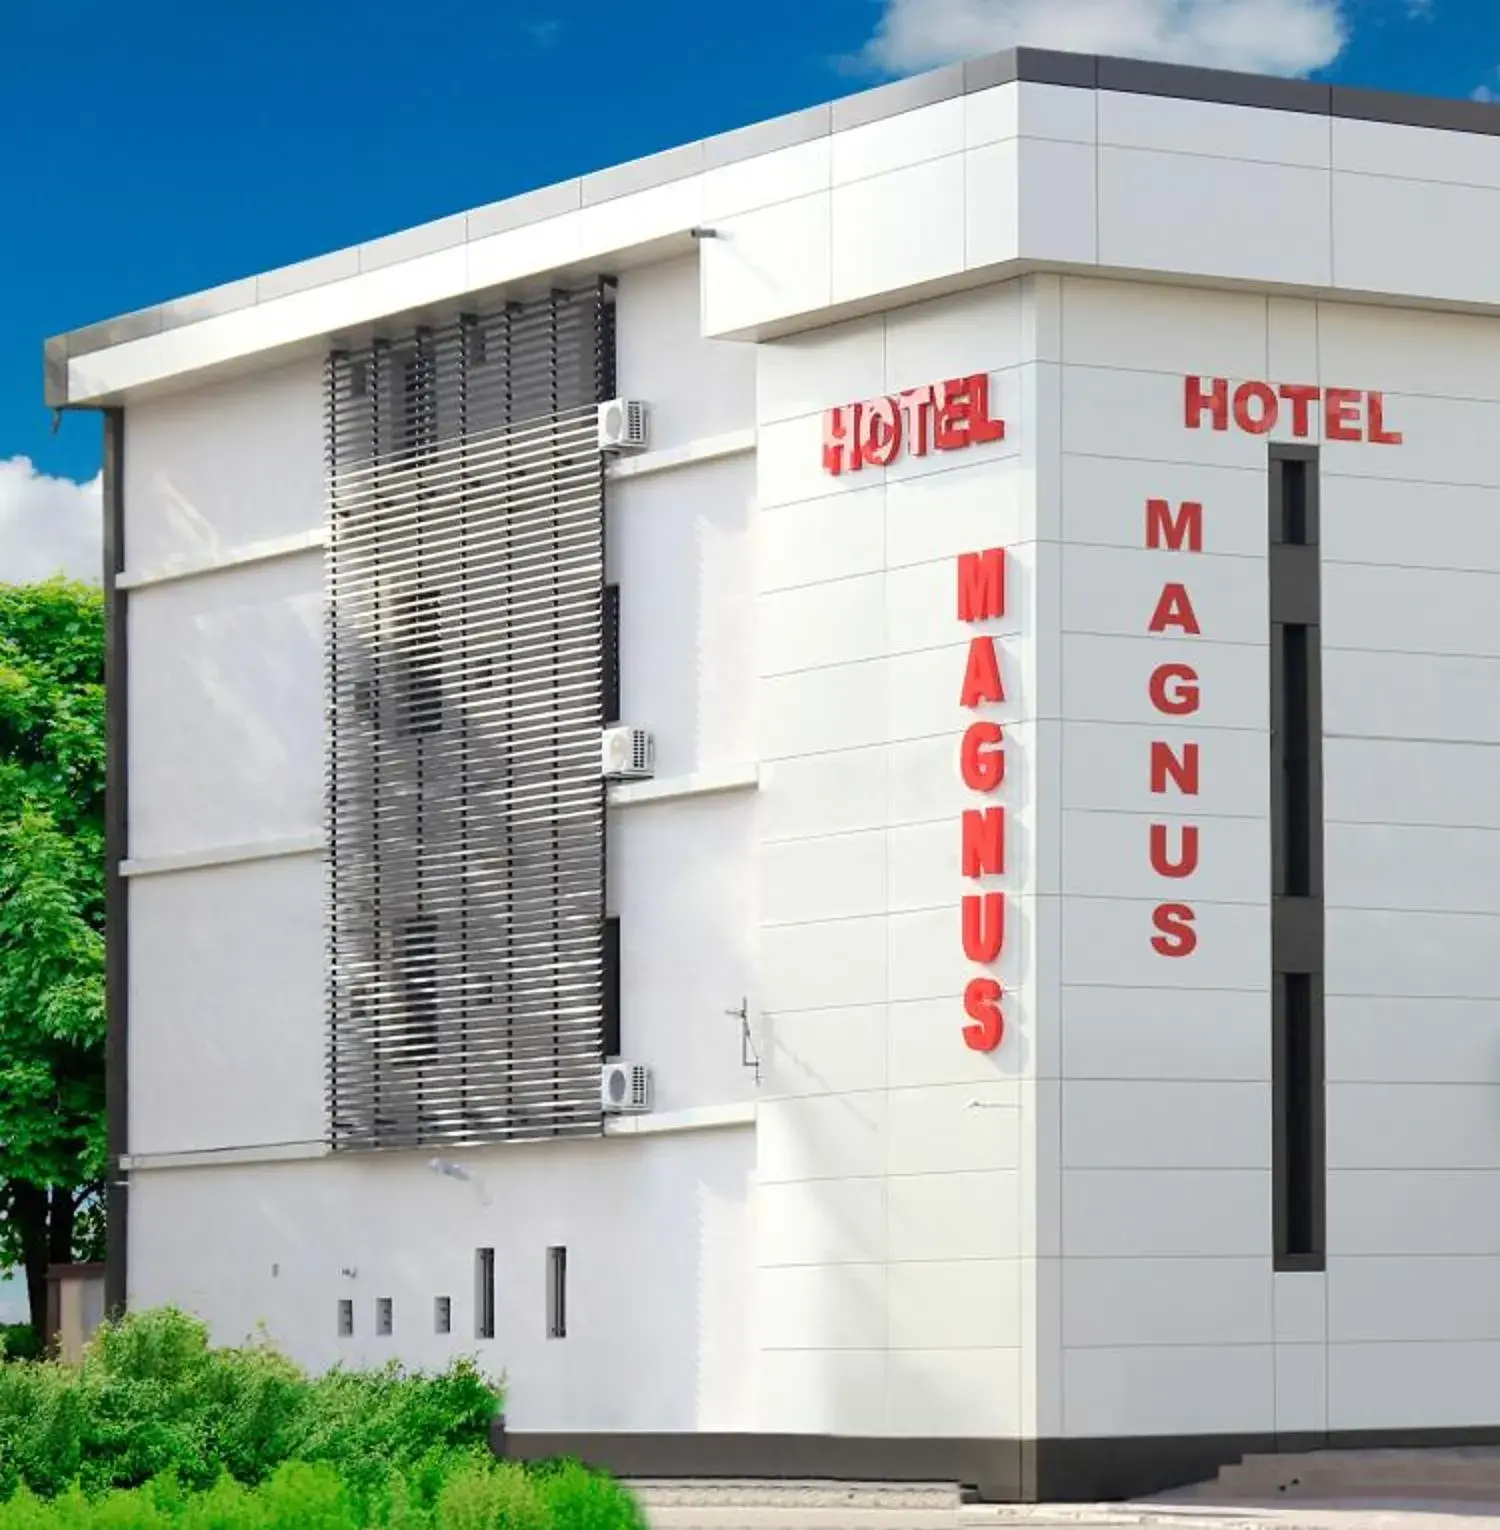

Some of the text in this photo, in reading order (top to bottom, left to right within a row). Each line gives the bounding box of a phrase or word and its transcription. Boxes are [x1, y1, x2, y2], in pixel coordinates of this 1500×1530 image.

[823, 373, 1004, 476] HOTEL
[1184, 375, 1400, 444] HOTEL
[957, 547, 1005, 1052] MAGNUS
[1146, 499, 1202, 956] MAGNUS
